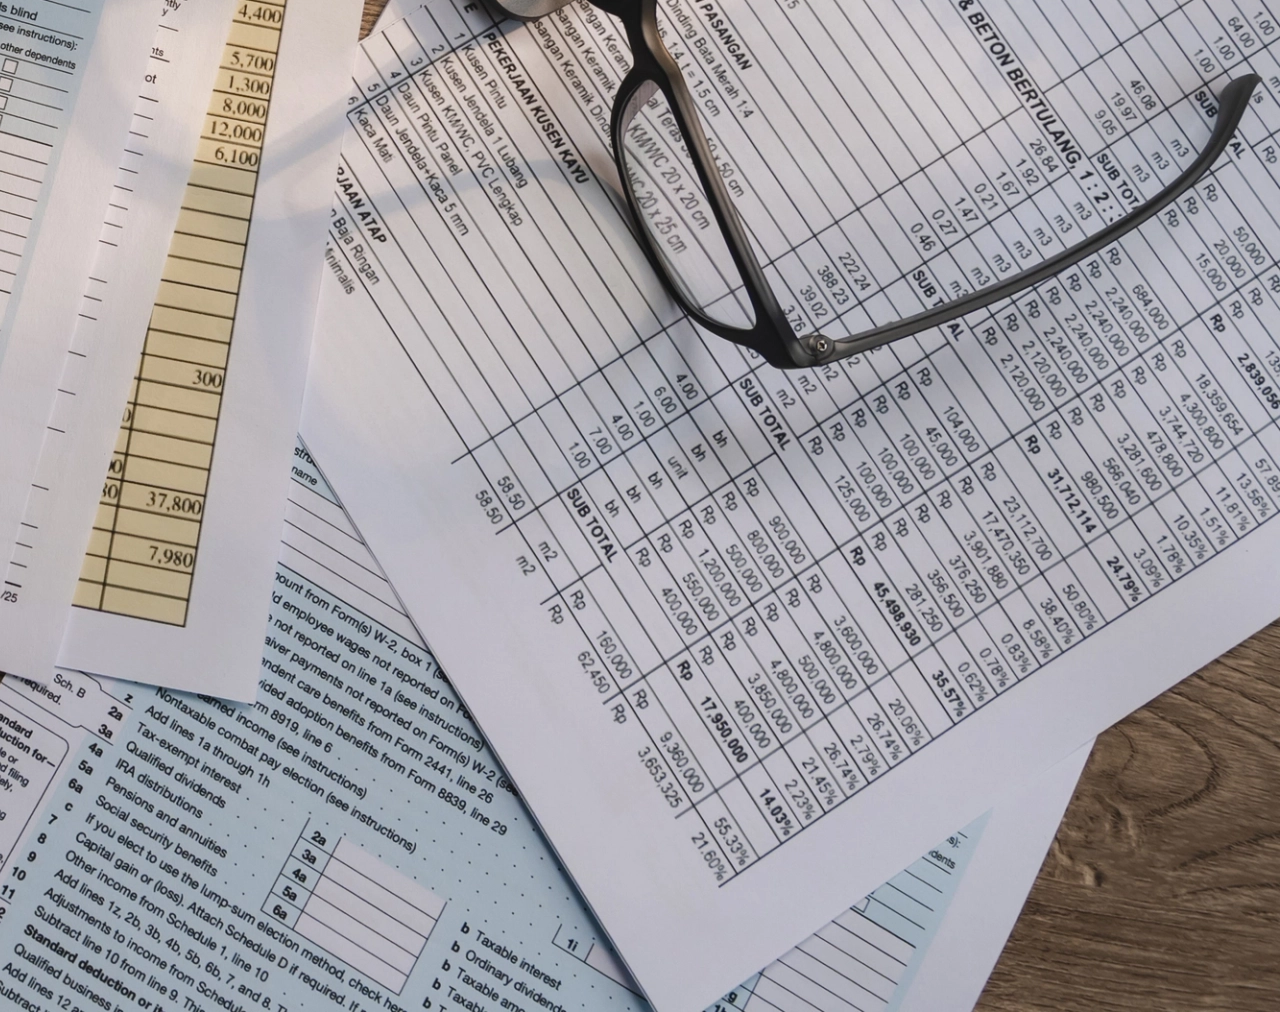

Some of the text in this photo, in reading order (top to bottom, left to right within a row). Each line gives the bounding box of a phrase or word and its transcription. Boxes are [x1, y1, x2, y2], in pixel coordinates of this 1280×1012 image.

[237, 4, 284, 26] 4,400
[229, 50, 277, 74] 5,700
[228, 74, 273, 98] 1,300
[222, 98, 267, 121] 8,000
[481, 30, 590, 184] PEKERJAAN KUSEN KAYU
[207, 120, 265, 145] 12,000
[214, 146, 260, 169] 6,100
[191, 369, 225, 391] 300
[145, 490, 205, 518] 37,800
[1046, 467, 1097, 534] 31,712,114
[566, 487, 618, 564] SUB TOTAL
[149, 544, 197, 572] 7,980
[873, 581, 922, 647] 45,498,930
[700, 695, 749, 764] 17,950,000
[136, 720, 242, 795] Tax-exempt interest
[125, 740, 227, 809] Qualified dividends
[759, 787, 797, 841] 14.03%
